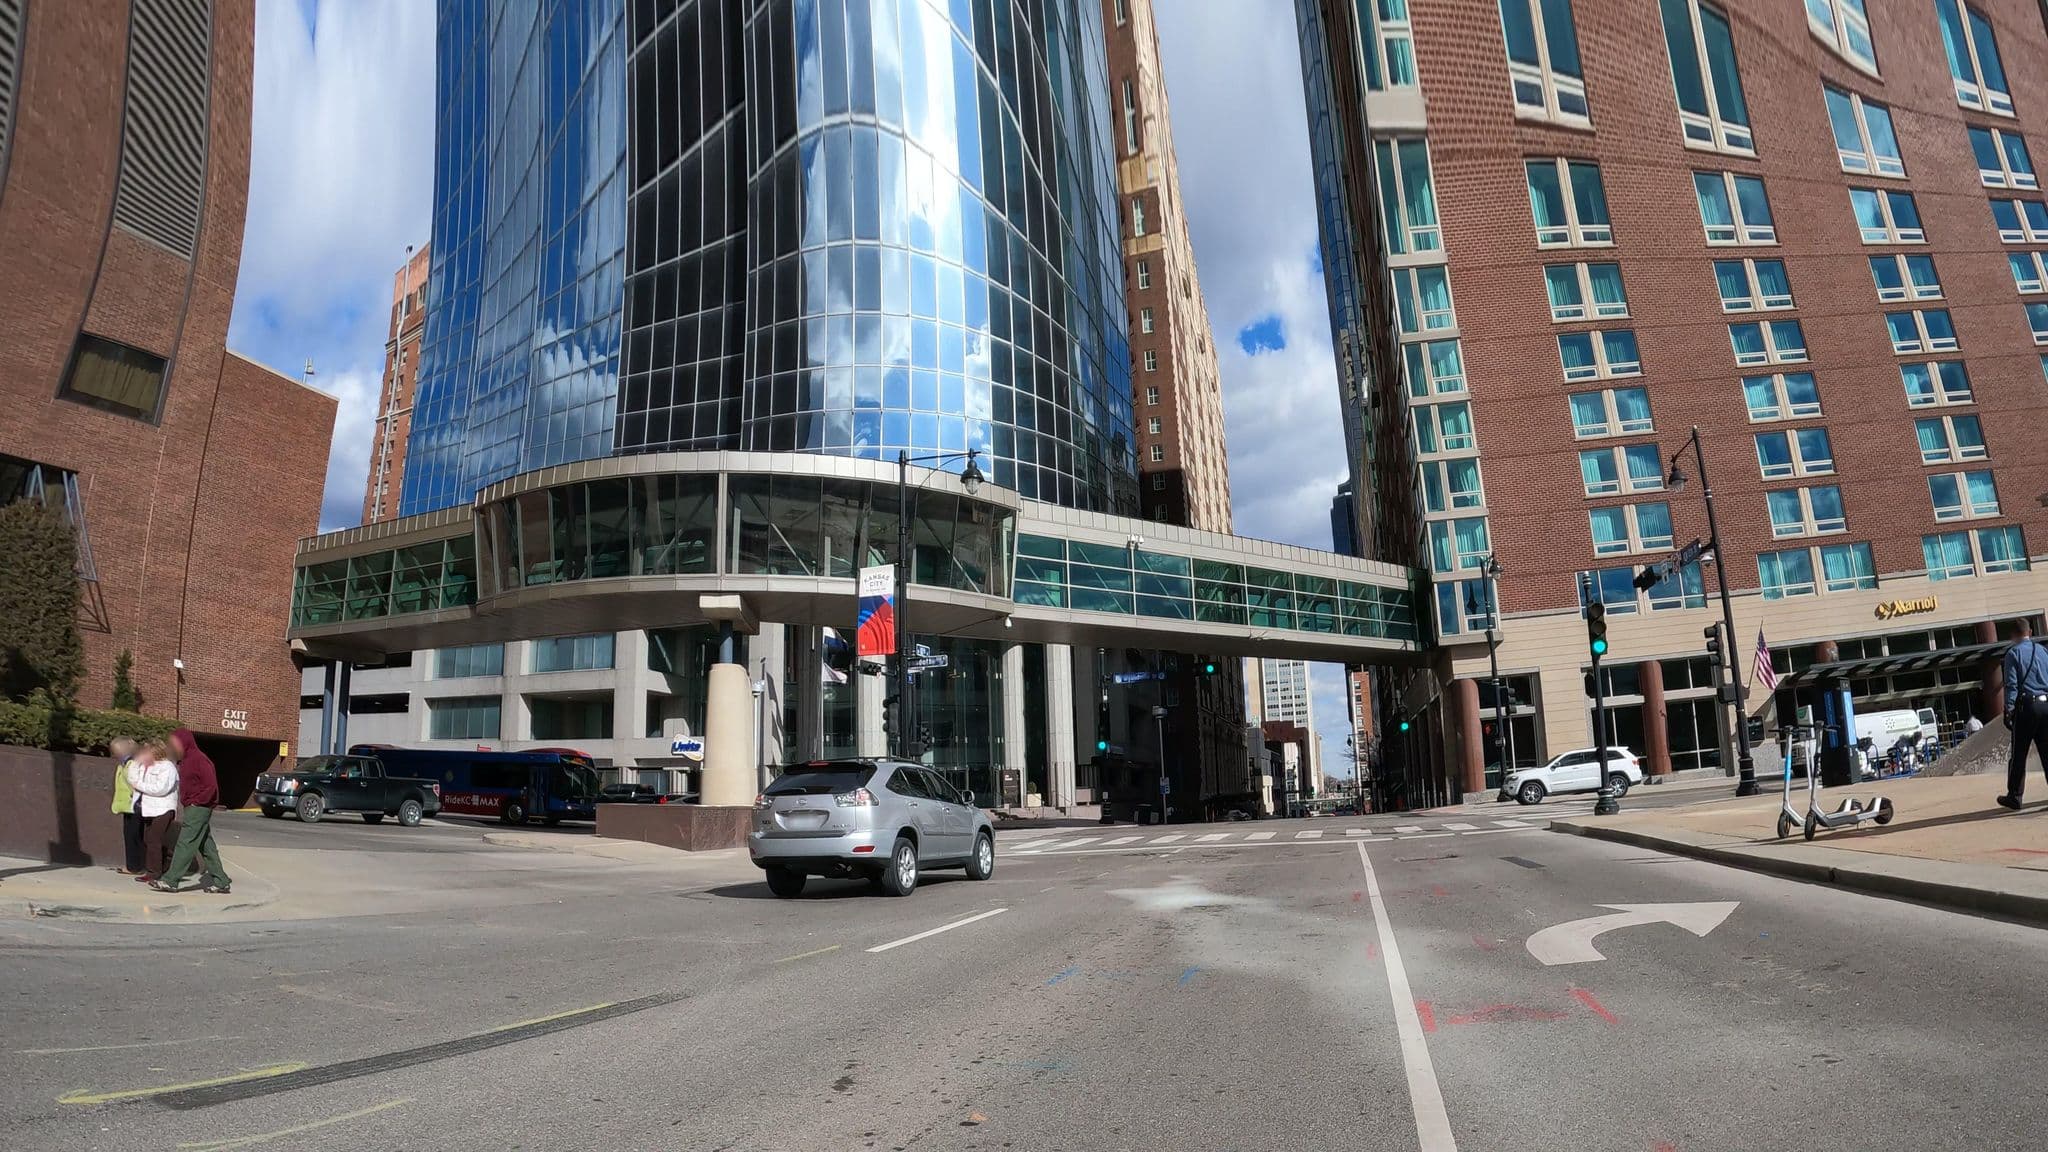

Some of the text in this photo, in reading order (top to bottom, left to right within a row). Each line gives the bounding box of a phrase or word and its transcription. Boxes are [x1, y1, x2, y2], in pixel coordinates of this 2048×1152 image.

[864, 574, 890, 583] KANSAS
[1892, 595, 1938, 615] Marriott
[224, 709, 248, 720] EXIT
[221, 719, 248, 731] ONLY
[444, 795, 500, 807] RideKC MAX
